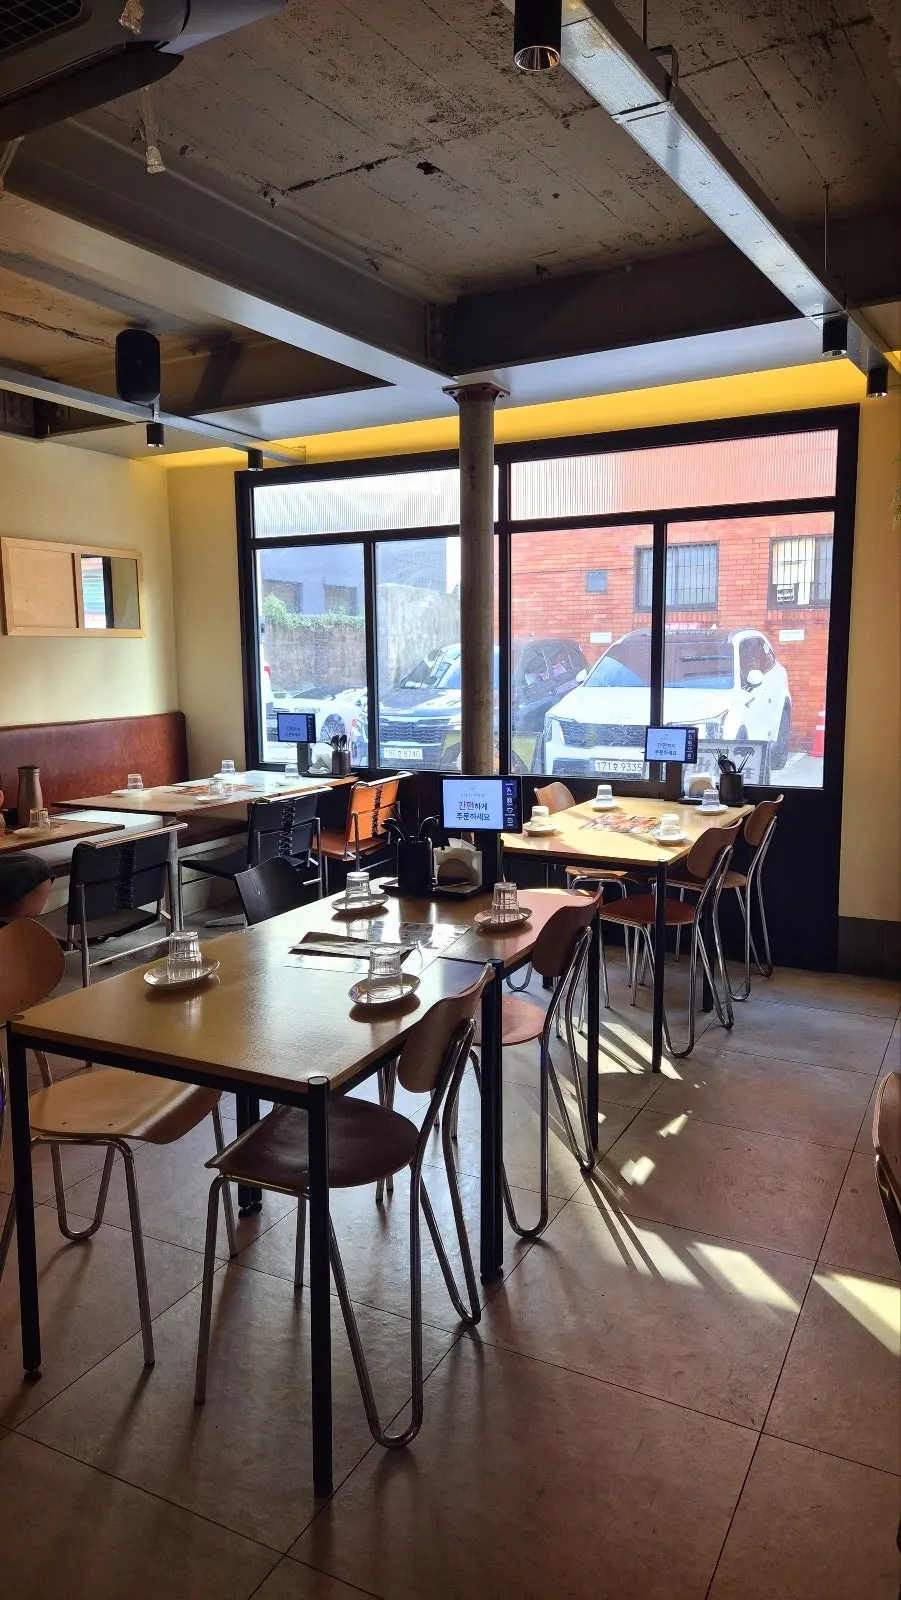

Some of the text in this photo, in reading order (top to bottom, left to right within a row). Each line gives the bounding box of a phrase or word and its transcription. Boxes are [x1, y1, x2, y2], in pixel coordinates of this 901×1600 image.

[620, 762, 642, 772] 9335
[458, 801, 488, 811] 간편하게
[455, 812, 491, 821] 주문하세요
